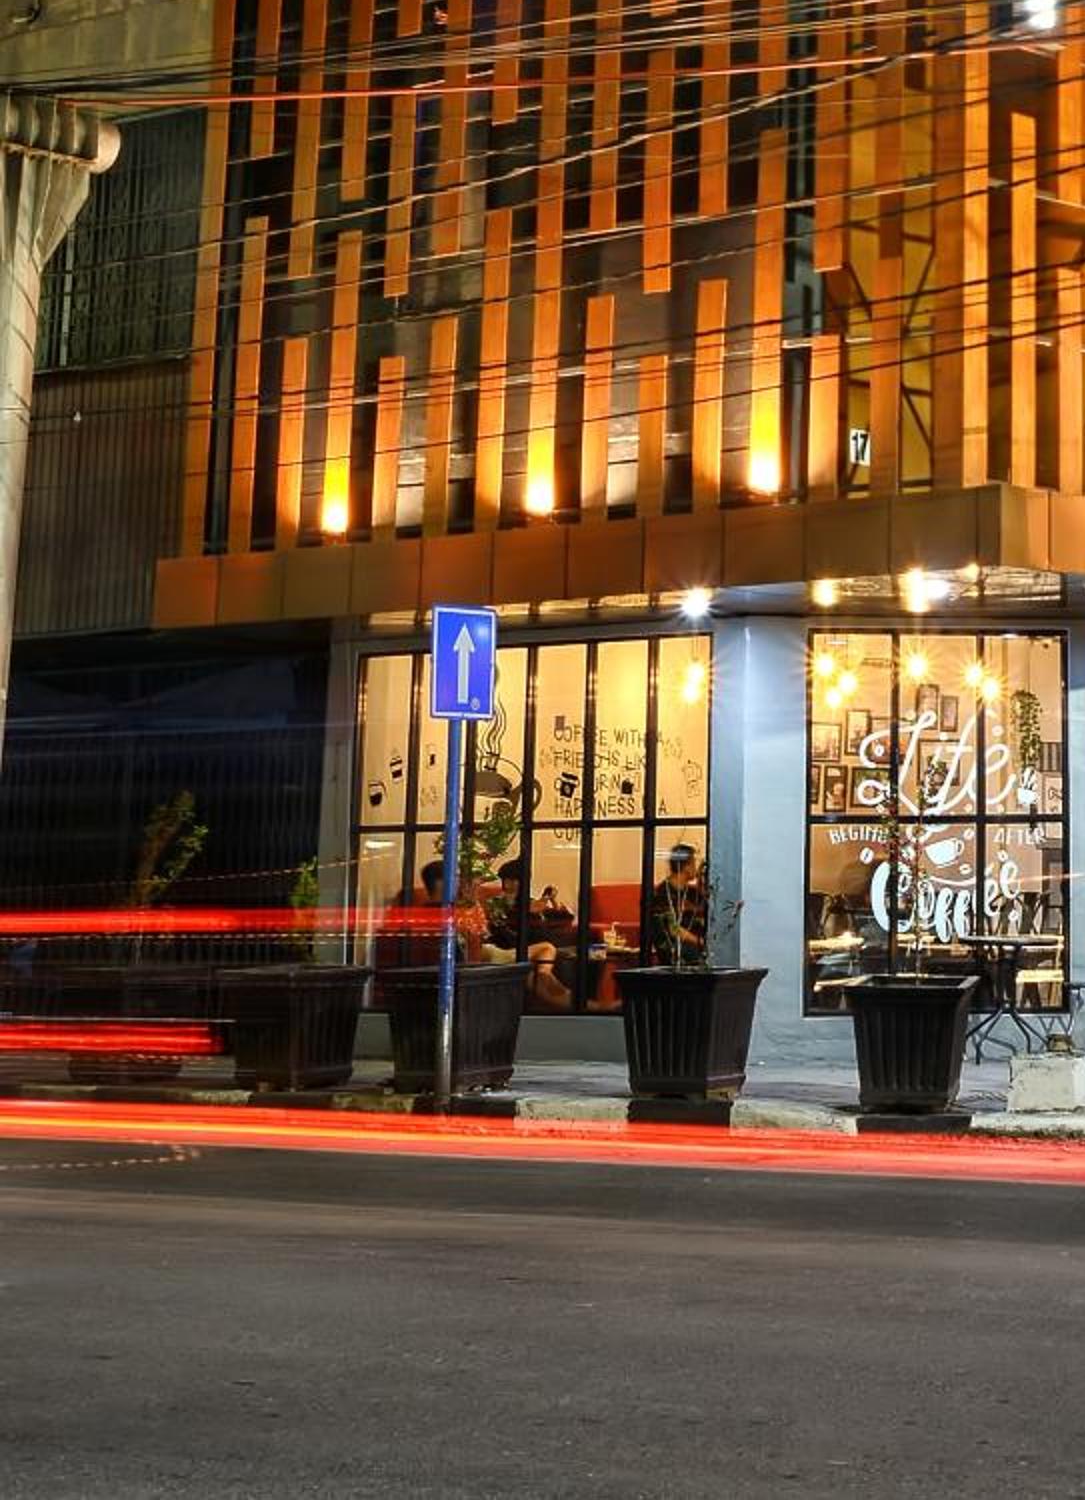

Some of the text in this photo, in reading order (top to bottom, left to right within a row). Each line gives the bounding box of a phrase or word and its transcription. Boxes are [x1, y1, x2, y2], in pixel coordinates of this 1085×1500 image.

[852, 432, 869, 461] 17
[554, 724, 607, 746] COFE
[555, 796, 635, 819] HAPNESS
[992, 823, 1047, 845] AFTER
